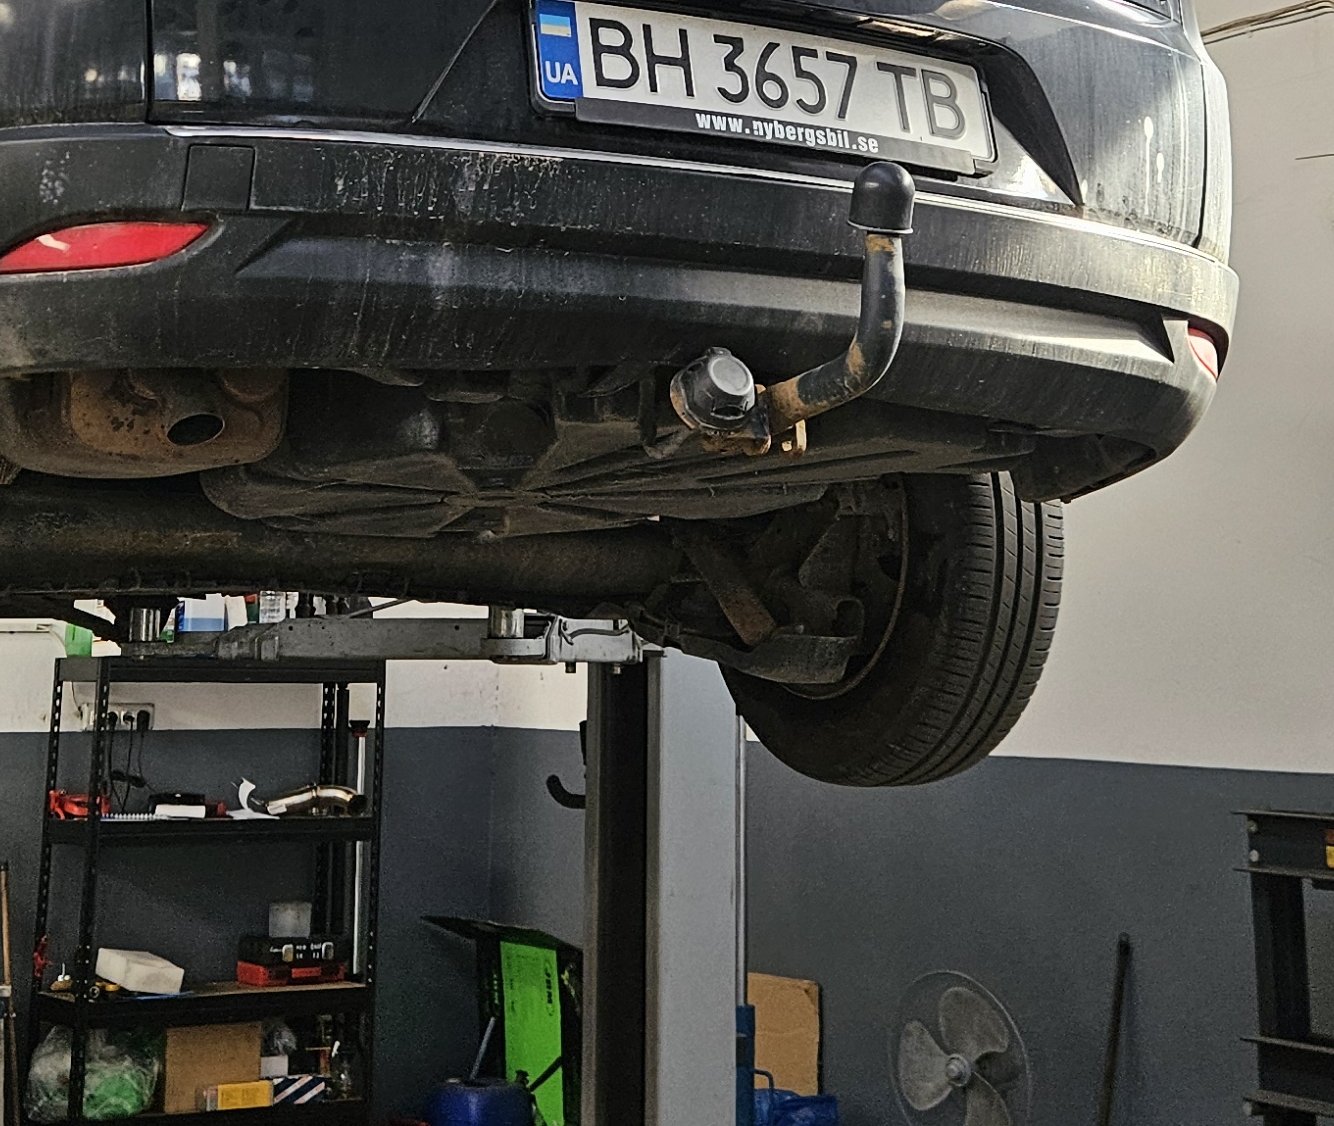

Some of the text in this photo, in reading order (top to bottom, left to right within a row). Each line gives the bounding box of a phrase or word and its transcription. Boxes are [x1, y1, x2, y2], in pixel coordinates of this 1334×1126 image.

[545, 60, 579, 85] UA
[588, 17, 966, 138] BH 3657 TB
[695, 112, 879, 154] www.nybergsbil.se
